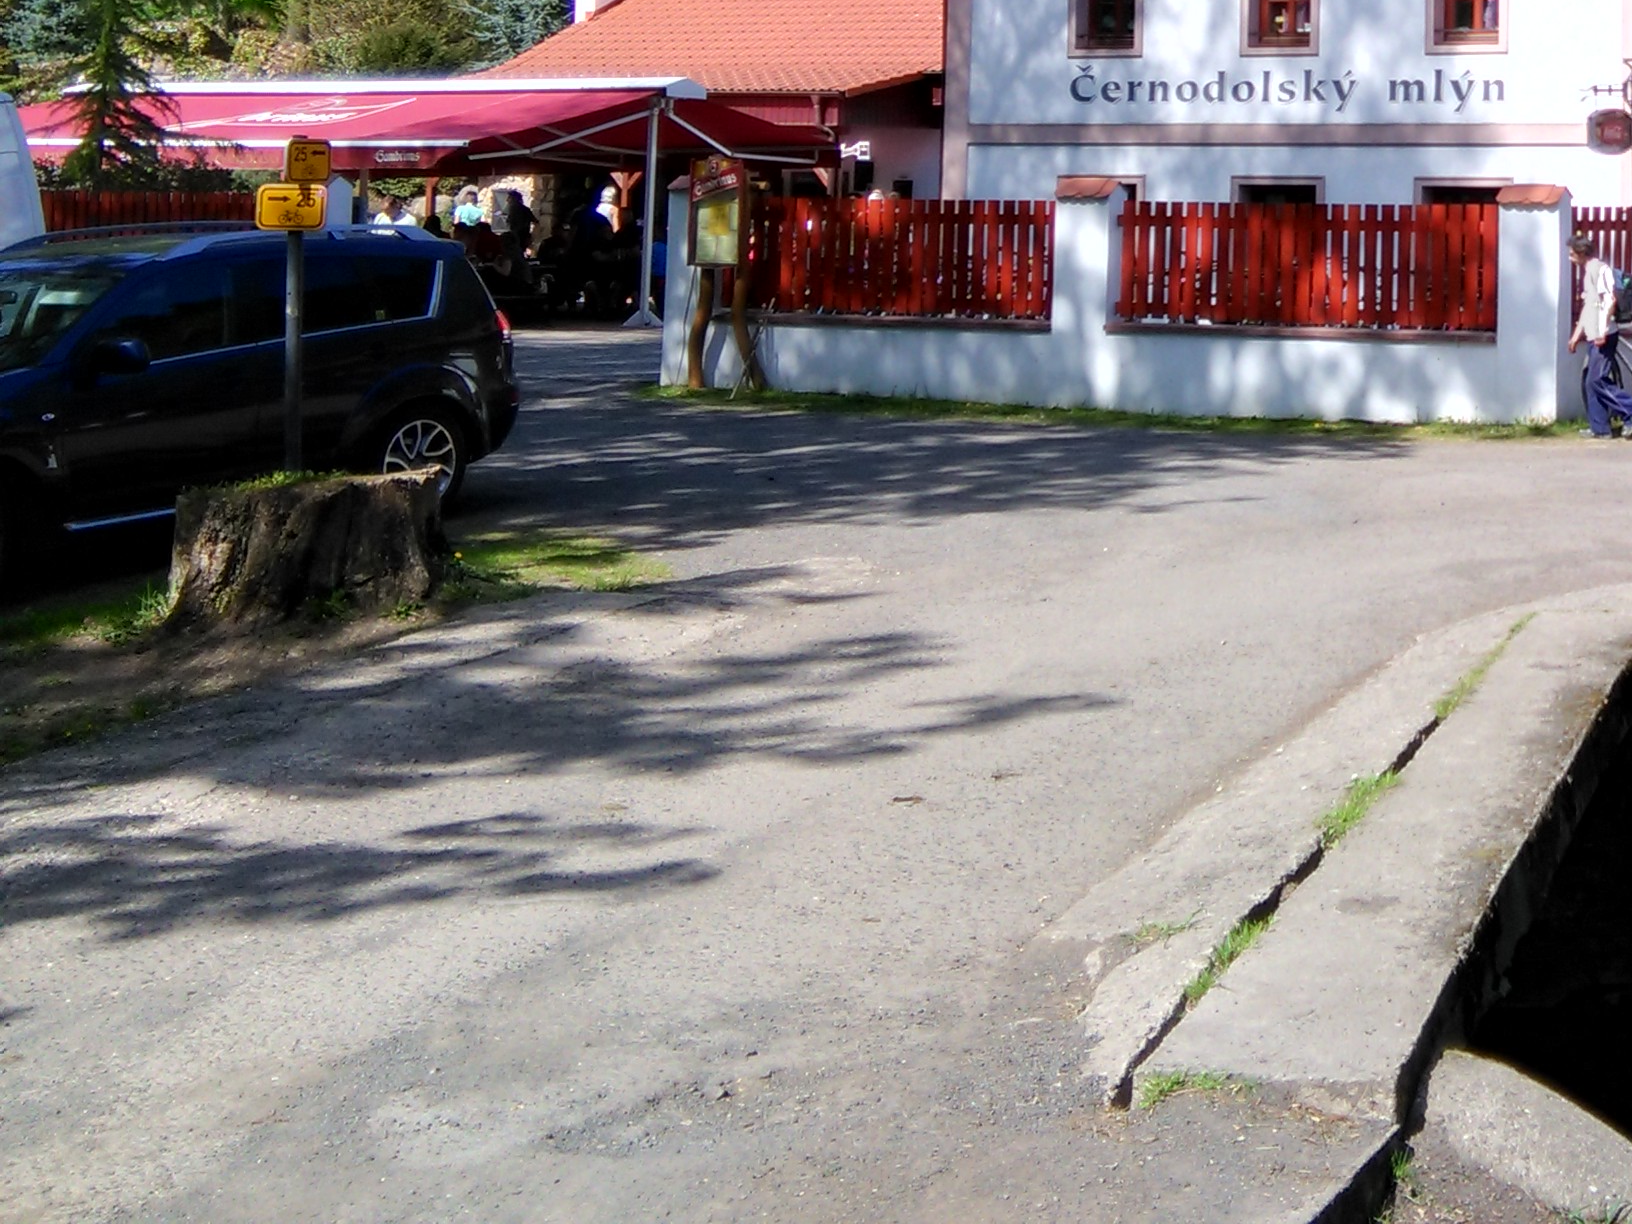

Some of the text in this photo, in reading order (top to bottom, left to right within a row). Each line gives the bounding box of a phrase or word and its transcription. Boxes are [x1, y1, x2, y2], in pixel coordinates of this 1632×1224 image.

[1069, 64, 1506, 114] Černodolský mlýn
[294, 146, 308, 162] 25
[296, 191, 317, 209] 25
